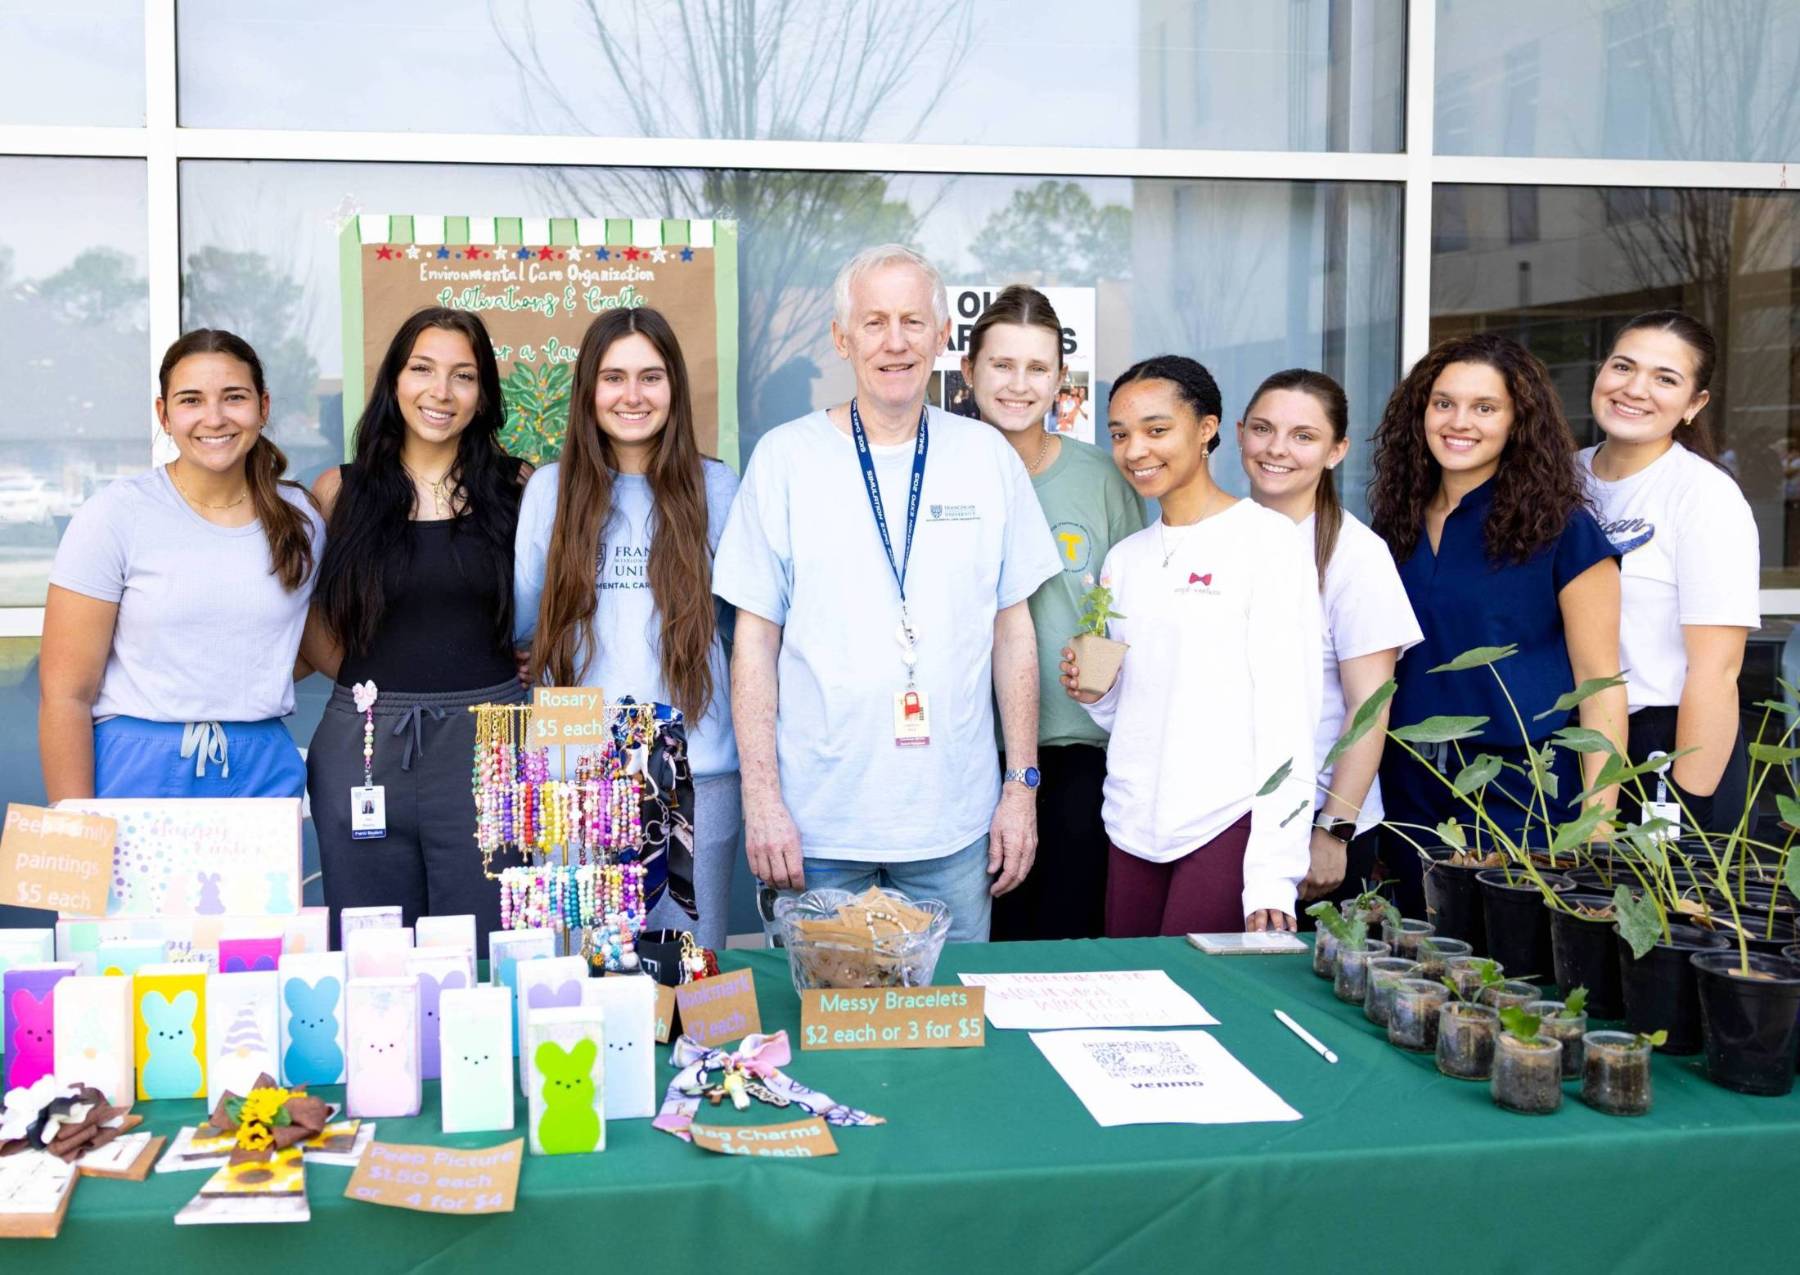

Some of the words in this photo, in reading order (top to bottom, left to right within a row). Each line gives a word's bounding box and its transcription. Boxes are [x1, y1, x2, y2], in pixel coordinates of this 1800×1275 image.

[420, 261, 526, 281] Environmental
[528, 262, 564, 283] Care
[567, 263, 656, 287] Organization
[436, 284, 560, 317] Cultivations
[519, 345, 536, 362] a
[866, 470, 884, 520] SIMULATION
[615, 546, 651, 557] FRAN
[615, 565, 643, 577] UNI
[596, 582, 630, 590] MENTAL
[539, 691, 598, 710] Rosary
[536, 719, 558, 738] $5
[563, 719, 601, 737] each
[15, 851, 100, 880] paintings
[16, 879, 42, 903] $5
[47, 889, 92, 911] each
[820, 994, 879, 1014] Messy
[885, 991, 967, 1009] Bracelets
[805, 1023, 828, 1046] $2
[834, 1022, 876, 1043] each
[882, 1025, 902, 1041] or
[907, 1021, 919, 1040] 3
[925, 1019, 952, 1039] for
[958, 1017, 981, 1038] $5
[1130, 1080, 1204, 1090] venmo
[737, 1125, 821, 1140] Charms
[370, 1148, 426, 1165] Peep
[758, 1145, 812, 1157] each
[436, 1174, 492, 1188] each
[355, 1186, 381, 1198] or
[407, 1192, 421, 1206] 4
[430, 1194, 467, 1209] for
[474, 1194, 503, 1210] $4
